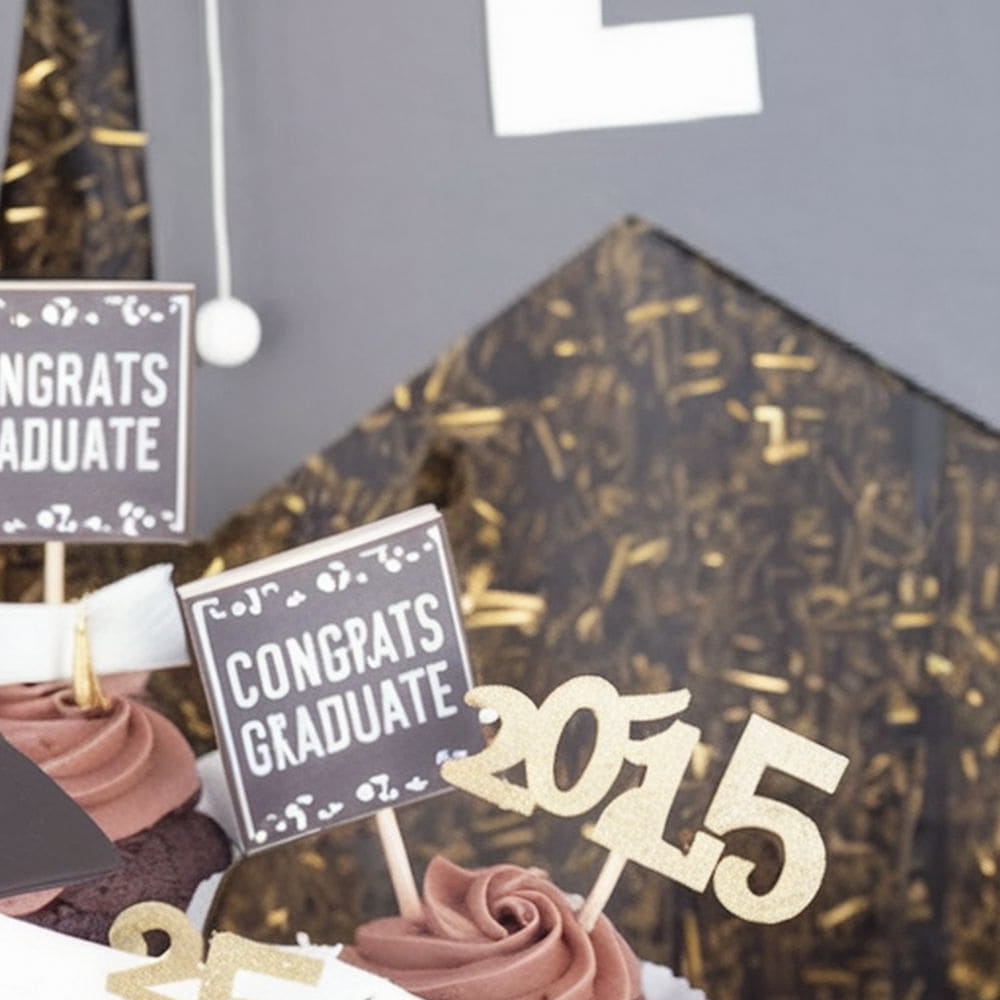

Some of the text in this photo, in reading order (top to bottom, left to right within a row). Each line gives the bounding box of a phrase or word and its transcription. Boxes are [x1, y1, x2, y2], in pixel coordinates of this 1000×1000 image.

[225, 593, 445, 709] CONGRATS
[240, 660, 458, 777] GRADUATE
[440, 674, 850, 925] 2015
